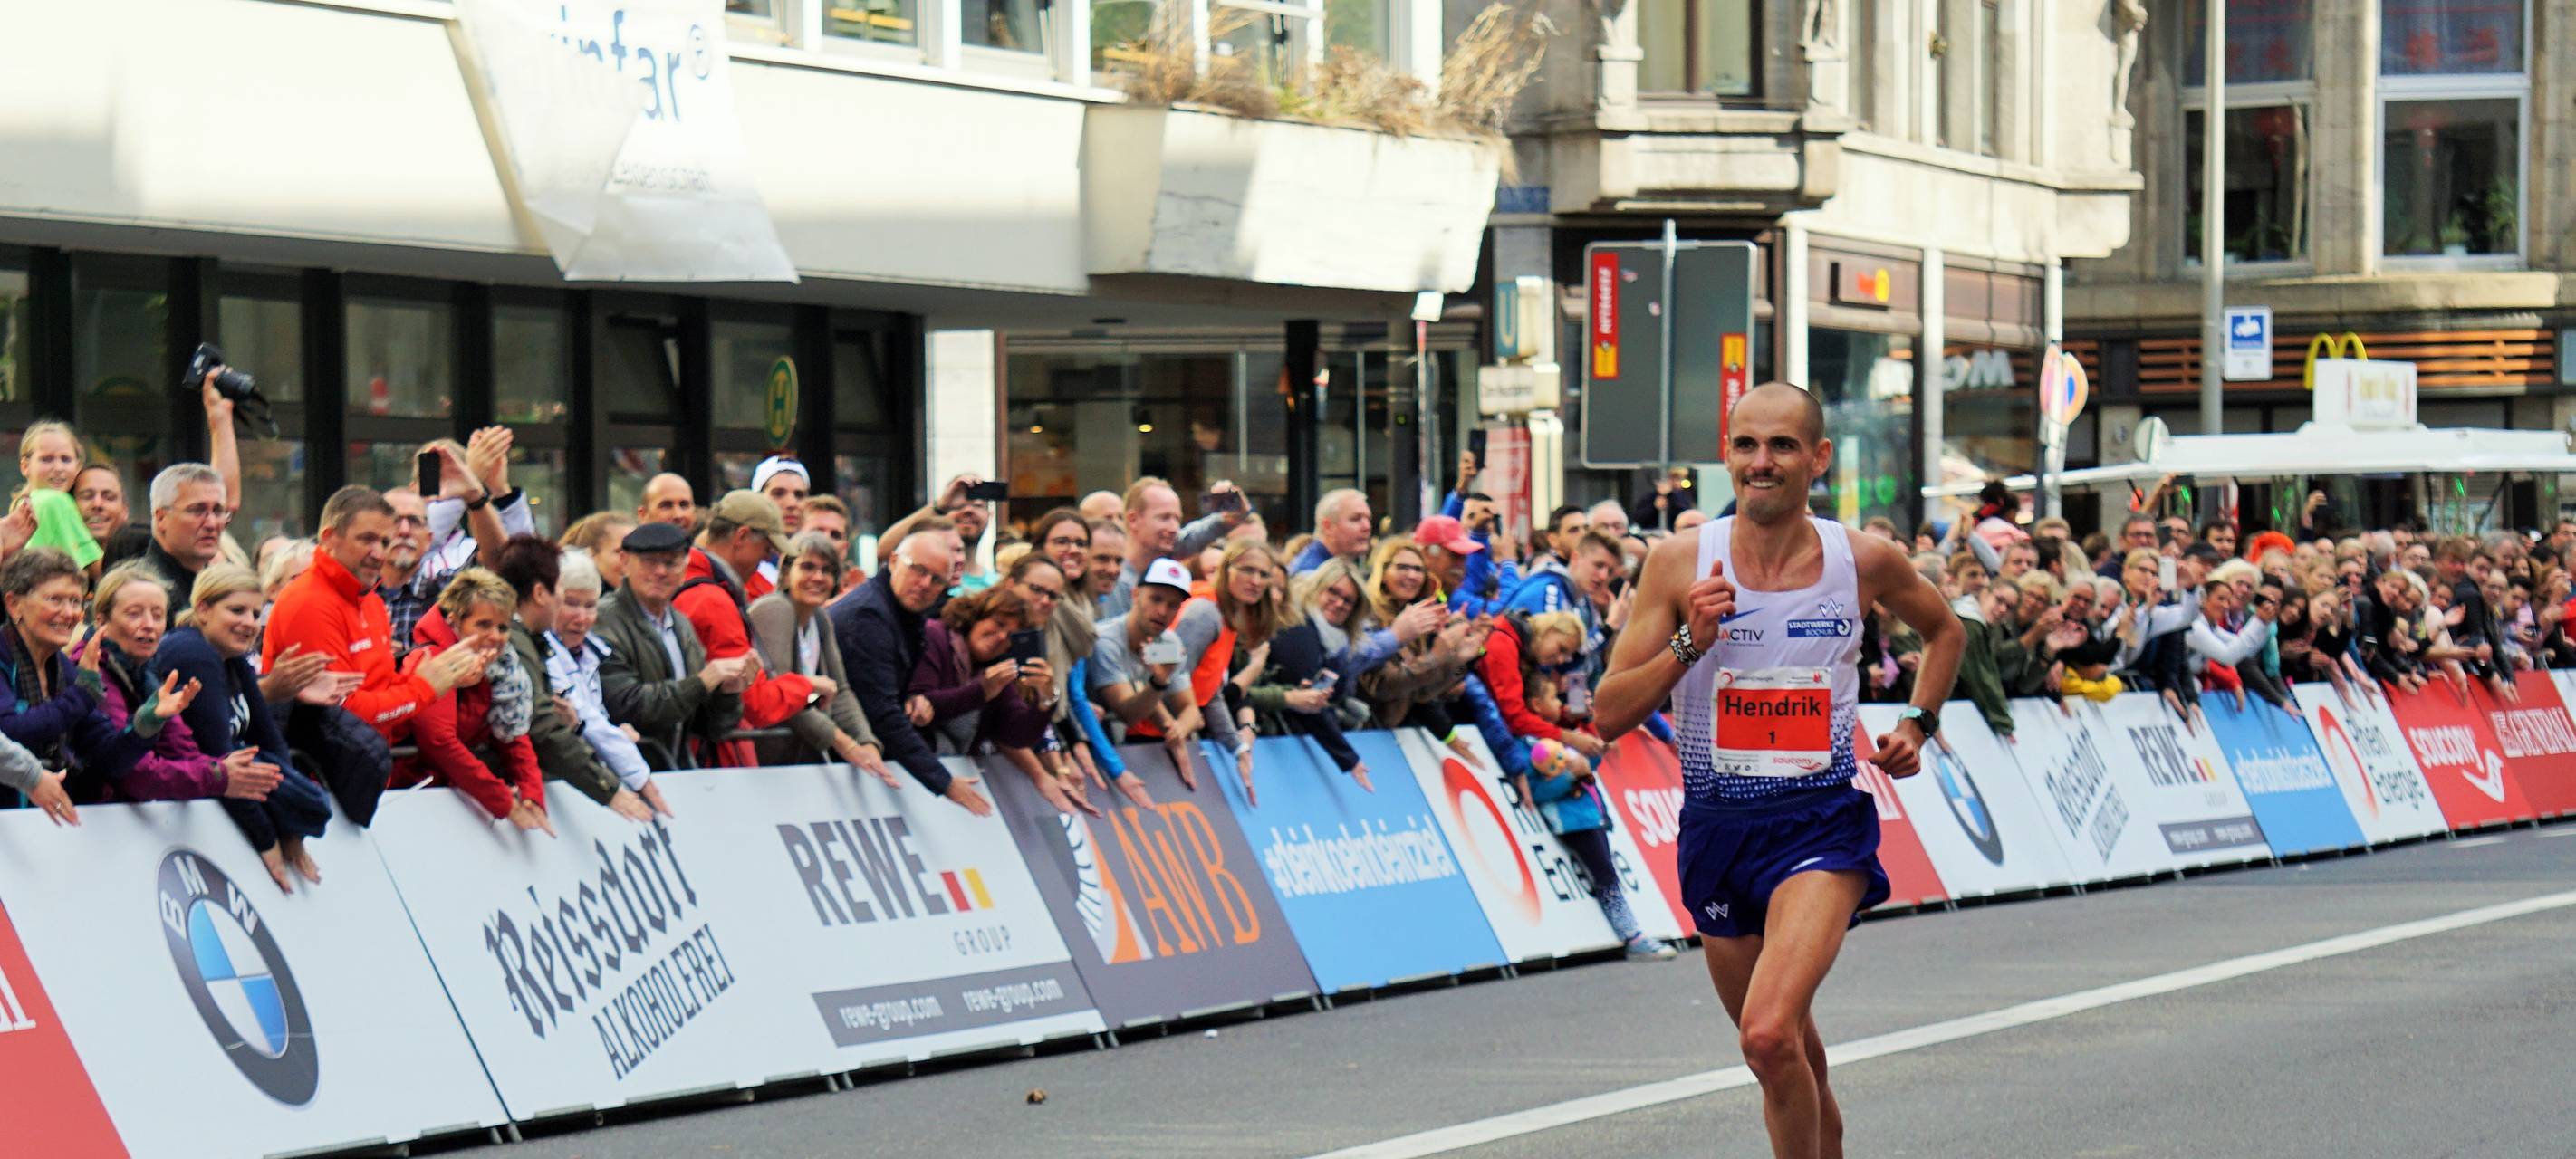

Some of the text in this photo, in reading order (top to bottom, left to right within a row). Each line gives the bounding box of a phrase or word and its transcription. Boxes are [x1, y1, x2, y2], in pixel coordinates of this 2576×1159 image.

[1725, 695, 1822, 717] Hendrik
[1767, 731, 1776, 745] 1
[2127, 725, 2201, 788] REWE
[2368, 761, 2425, 811] Energie
[159, 854, 259, 941] BMW
[775, 816, 951, 927] REWE
[1107, 800, 1260, 957] AWB
[953, 924, 1013, 956] GROUP
[591, 922, 736, 1081] ALKOHOLFREI
[839, 976, 1065, 1031] rewe-group.com rewe-group.com
